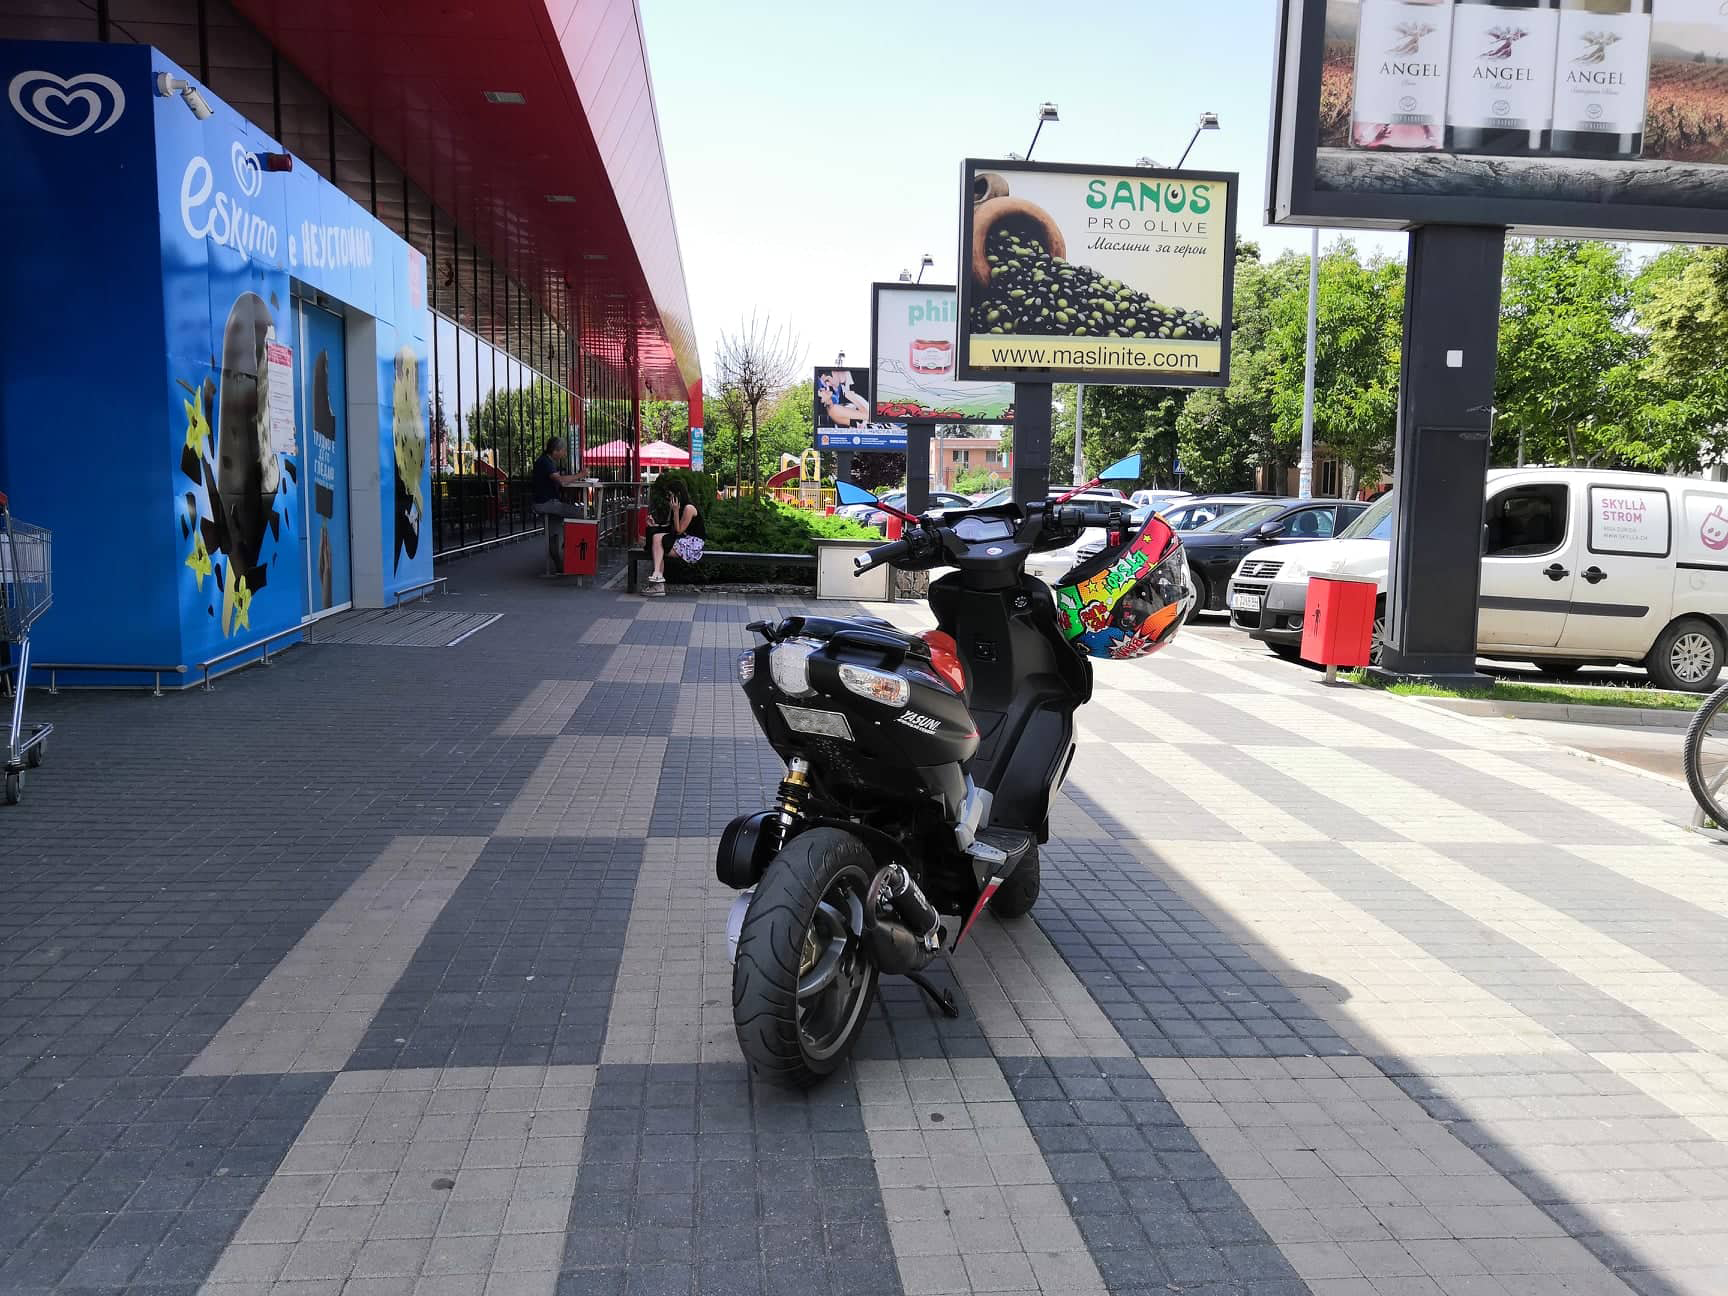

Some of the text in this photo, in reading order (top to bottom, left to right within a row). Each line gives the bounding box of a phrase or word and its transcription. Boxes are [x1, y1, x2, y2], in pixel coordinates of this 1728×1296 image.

[1379, 61, 1441, 77] ANGEL
[1472, 66, 1535, 81] ANGEL
[1565, 70, 1626, 86] ANGEL
[1086, 179, 1211, 214] SANUS
[1088, 217, 1208, 235] PRO OLIVE
[1087, 236, 1208, 258] Маслини за герои
[991, 346, 1200, 369] www.maslinite.com
[1602, 510, 1643, 523] STROM
